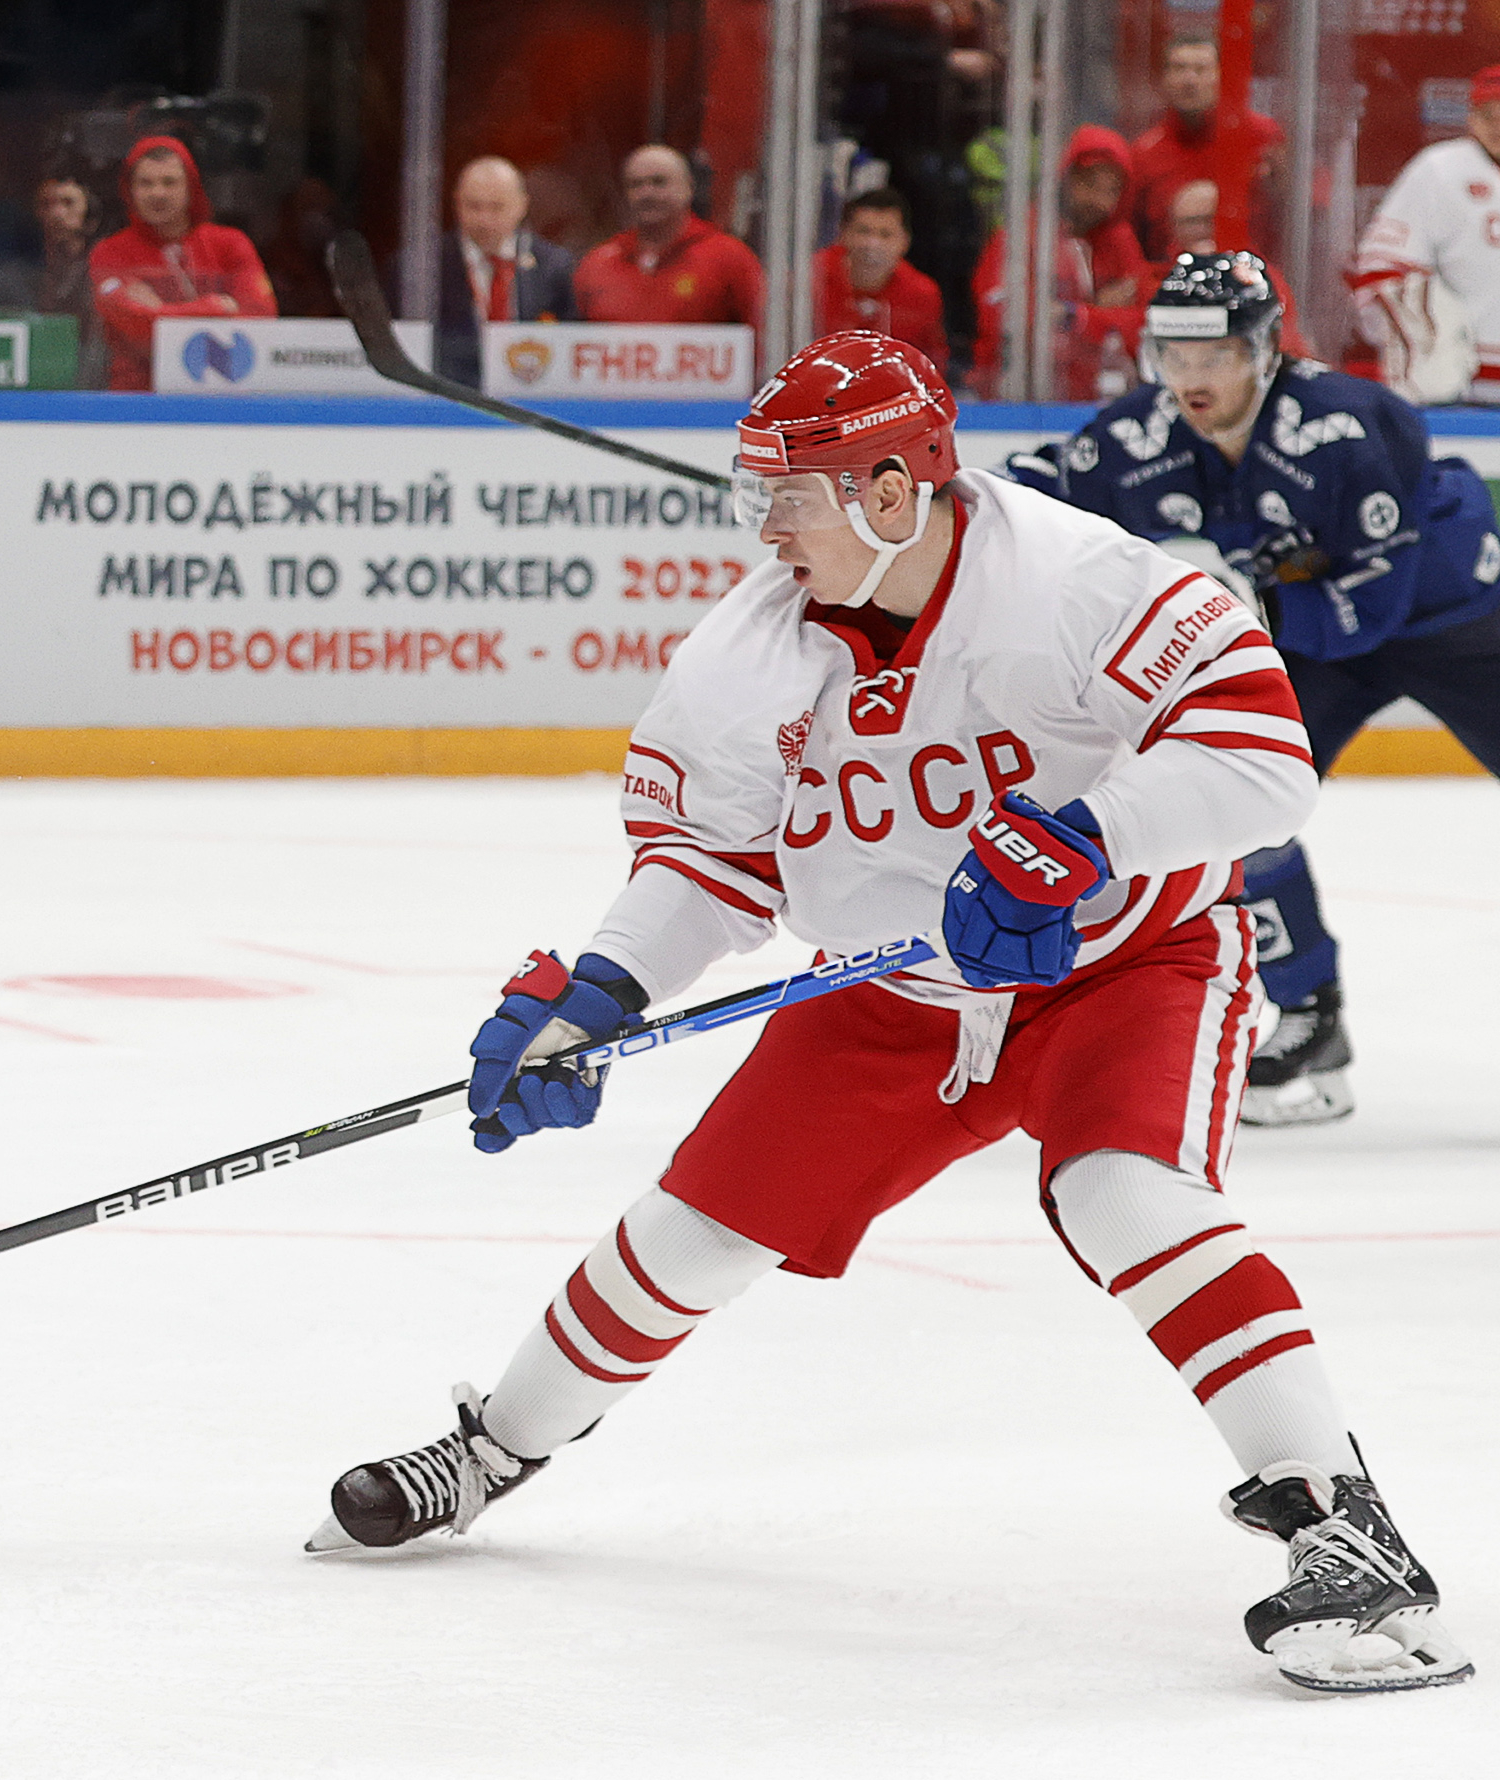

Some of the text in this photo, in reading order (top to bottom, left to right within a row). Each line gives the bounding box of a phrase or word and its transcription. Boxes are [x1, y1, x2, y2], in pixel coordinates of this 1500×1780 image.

[571, 341, 733, 383] FHR.RU
[841, 402, 909, 435] БАЛТИКА
[35, 470, 450, 533] МОЛОДЁЖНЫЙ
[97, 555, 245, 599] МИРА
[269, 556, 339, 599] ПО
[364, 555, 595, 599] ХОККЕЮ
[129, 629, 506, 673] НОВОСИБИРСК
[96, 1139, 301, 1223] BAUER
